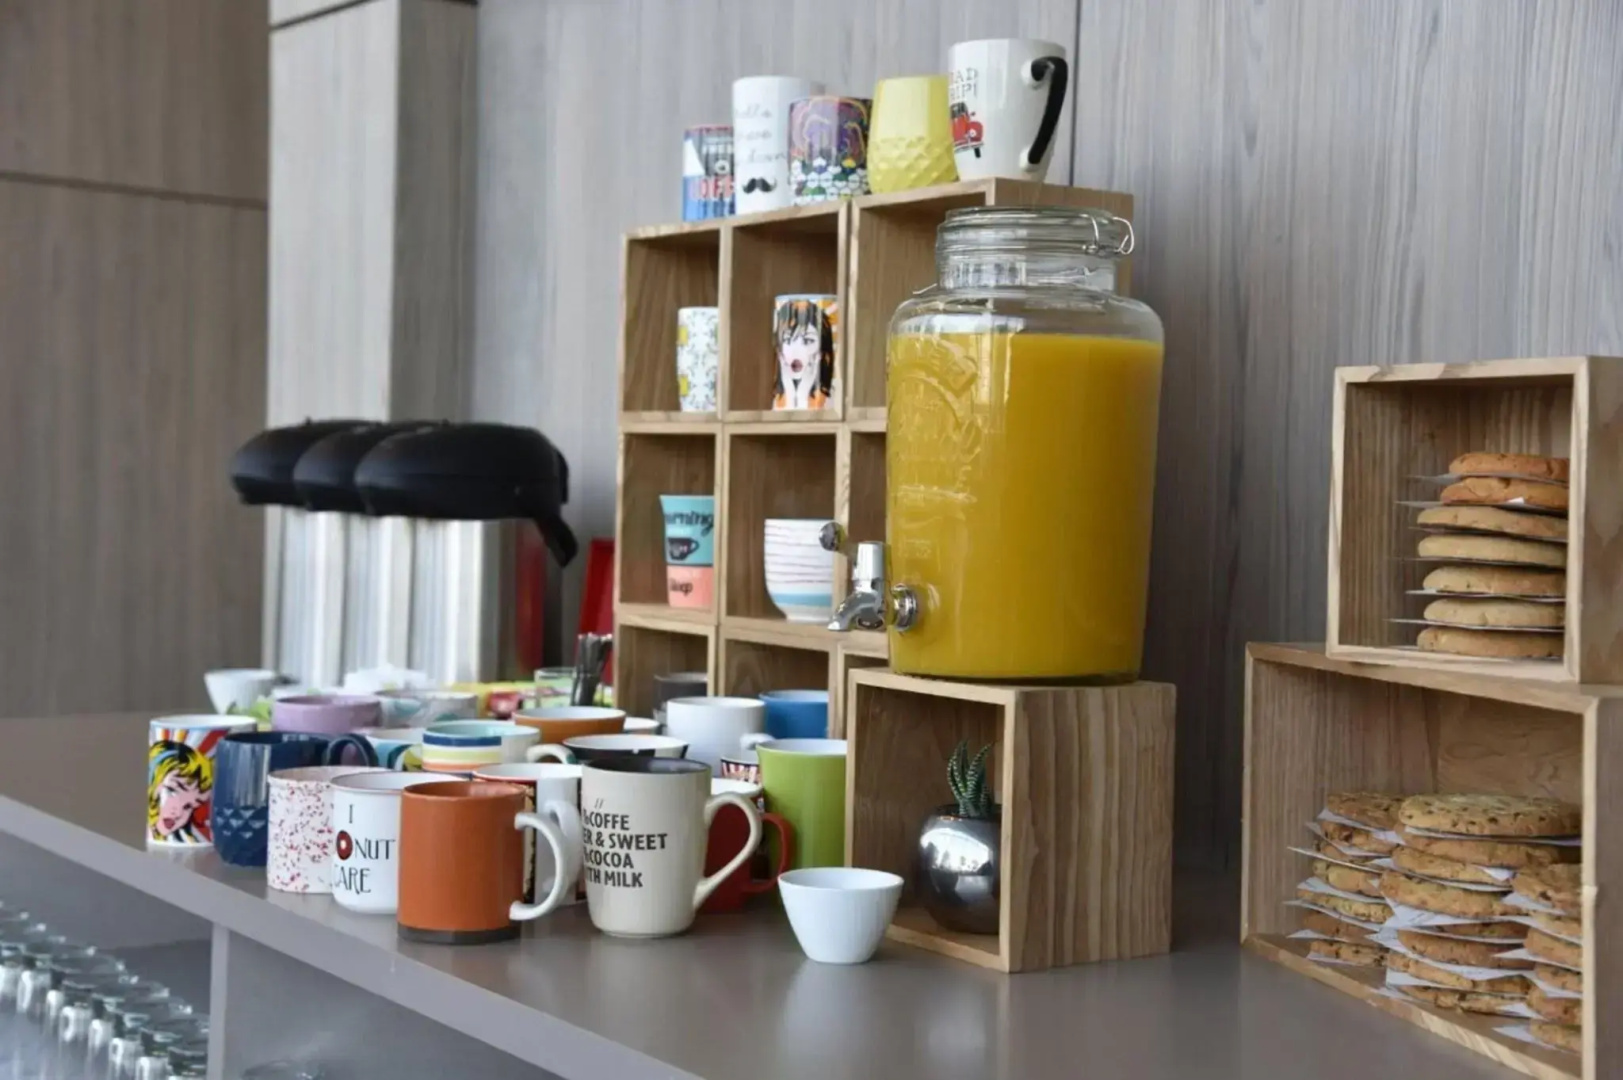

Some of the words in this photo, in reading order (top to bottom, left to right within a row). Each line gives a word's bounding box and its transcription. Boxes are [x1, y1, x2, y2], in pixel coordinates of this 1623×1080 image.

[348, 803, 354, 825] I
[595, 831, 605, 848] &
[608, 833, 668, 851] SWEET
[604, 870, 644, 888] MILK
